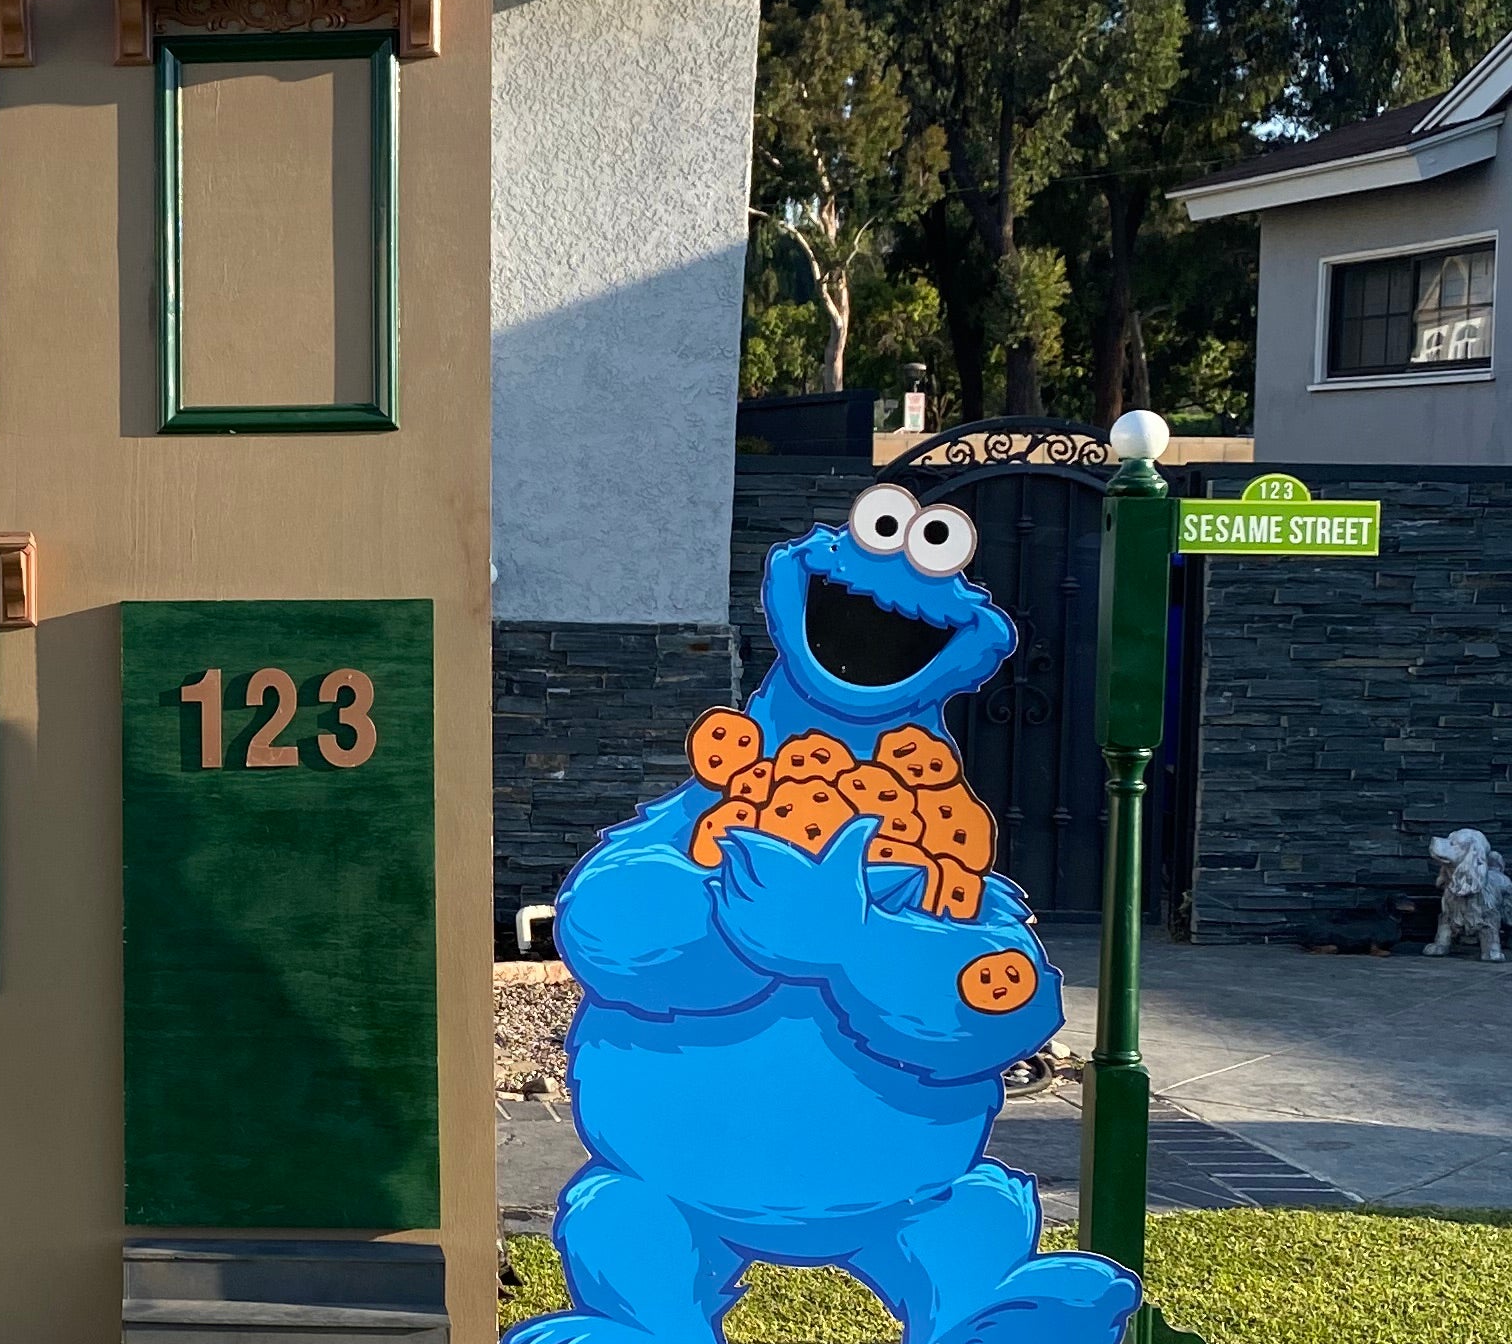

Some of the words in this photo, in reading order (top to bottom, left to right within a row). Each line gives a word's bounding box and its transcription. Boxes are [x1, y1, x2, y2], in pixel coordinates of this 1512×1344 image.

[1259, 481, 1294, 500] 123
[1183, 513, 1284, 544] SESAME
[1288, 515, 1373, 546] STREET
[180, 667, 377, 768] 123
